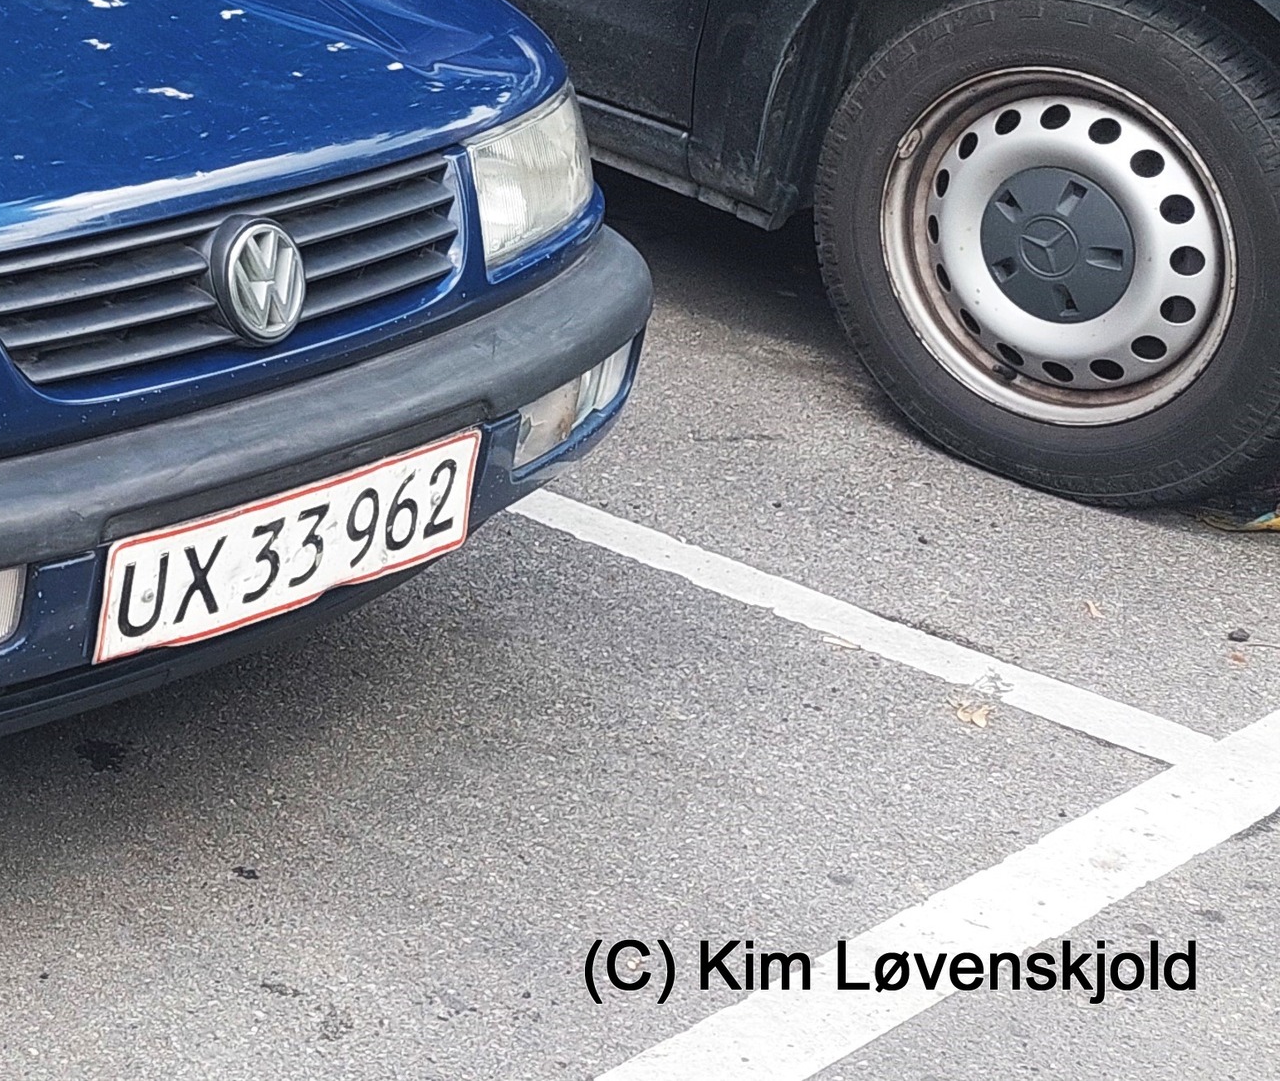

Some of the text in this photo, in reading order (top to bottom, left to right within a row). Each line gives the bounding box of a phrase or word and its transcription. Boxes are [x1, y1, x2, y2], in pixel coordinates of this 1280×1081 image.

[233, 227, 302, 334] VW
[117, 458, 458, 637] UX 33 962
